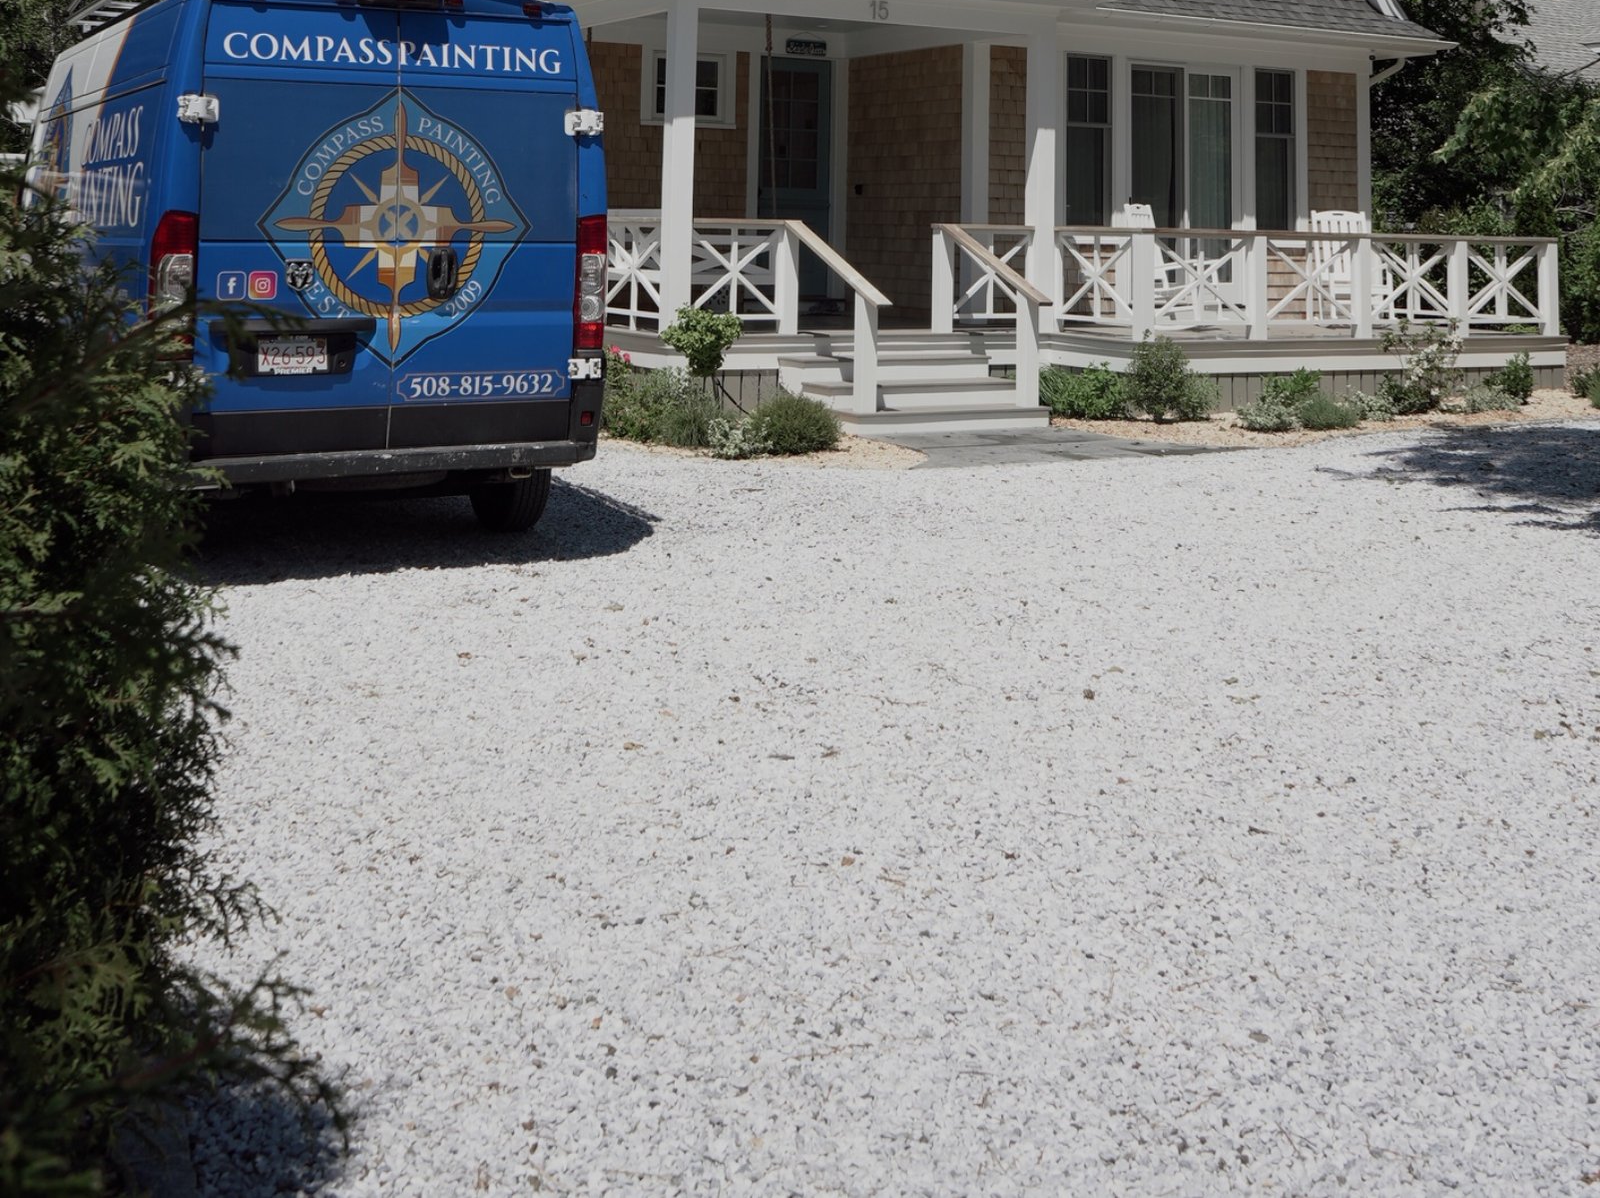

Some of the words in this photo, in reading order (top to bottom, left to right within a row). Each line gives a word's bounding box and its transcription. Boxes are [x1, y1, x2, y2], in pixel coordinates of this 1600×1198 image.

[869, 0, 889, 20] 15
[223, 32, 392, 65] COMPASS
[400, 41, 562, 75] PAINTING
[297, 116, 384, 196] COMPASS
[418, 117, 501, 204] PAINTING
[445, 280, 482, 320] 2009
[409, 373, 553, 399] 508-815-9632
